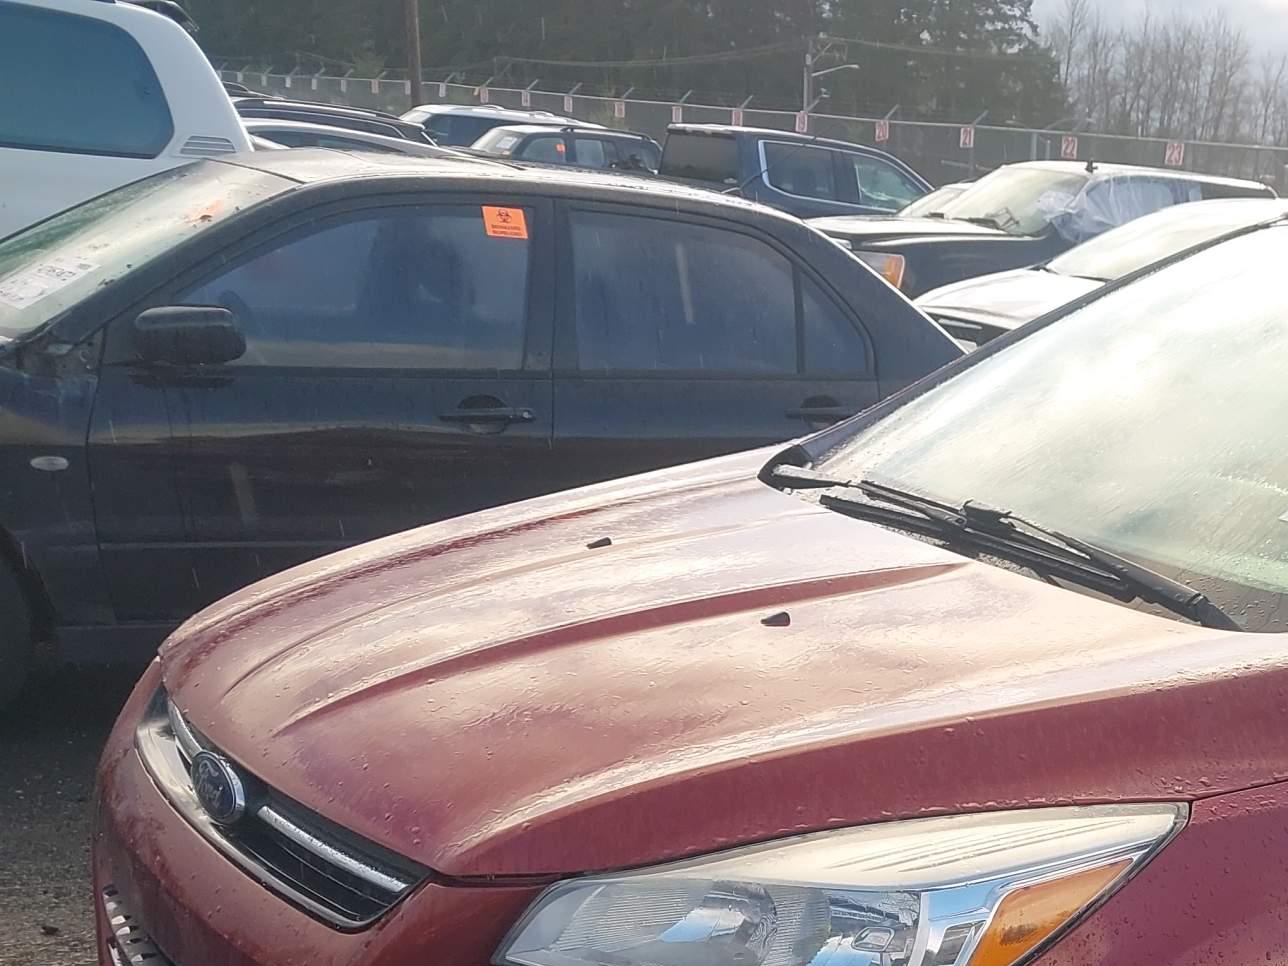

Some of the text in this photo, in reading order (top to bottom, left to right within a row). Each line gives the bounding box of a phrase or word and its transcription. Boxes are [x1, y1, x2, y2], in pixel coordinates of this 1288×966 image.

[962, 127, 972, 145] 21
[1062, 136, 1076, 158] 22
[1167, 143, 1183, 164] 23
